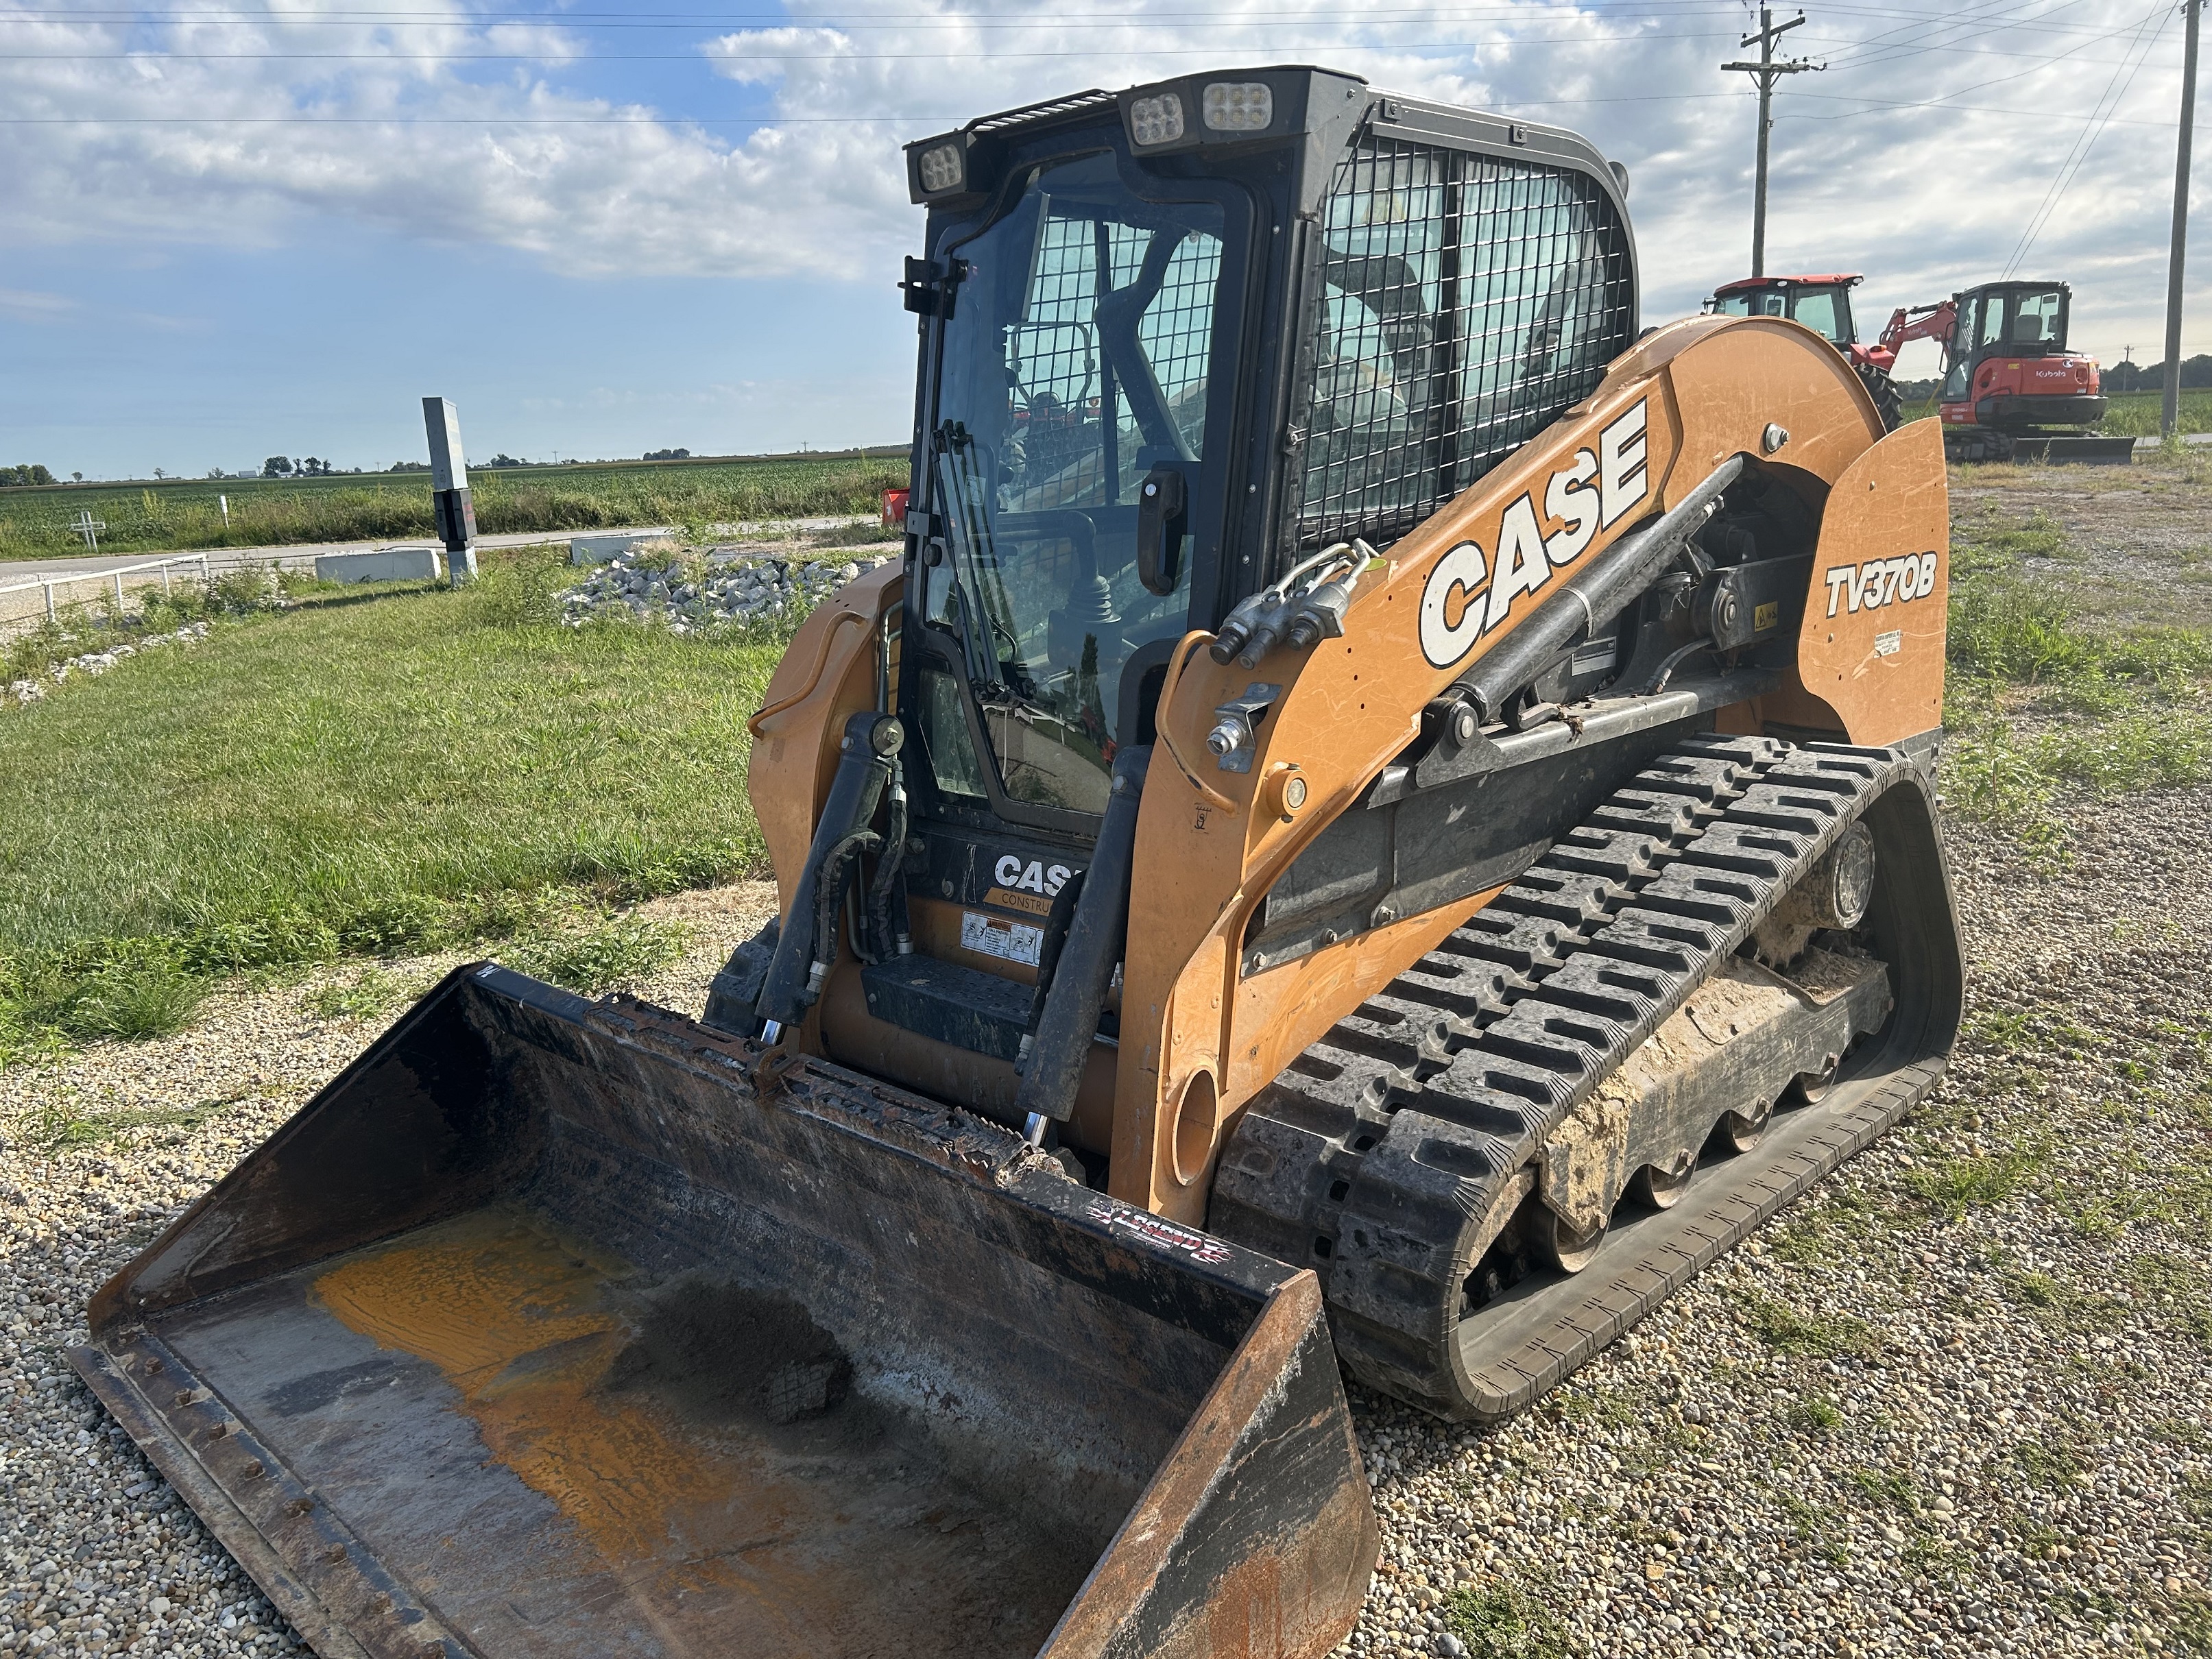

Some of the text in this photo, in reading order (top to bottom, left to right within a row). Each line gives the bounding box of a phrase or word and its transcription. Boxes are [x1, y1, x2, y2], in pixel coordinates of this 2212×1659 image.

[1419, 395, 1647, 670] CASE
[1825, 551, 1938, 620] TV370B
[995, 855, 1083, 897] CAS
[1002, 893, 1050, 912] CONSTRU
[1114, 1210, 1204, 1250] LEGEND
